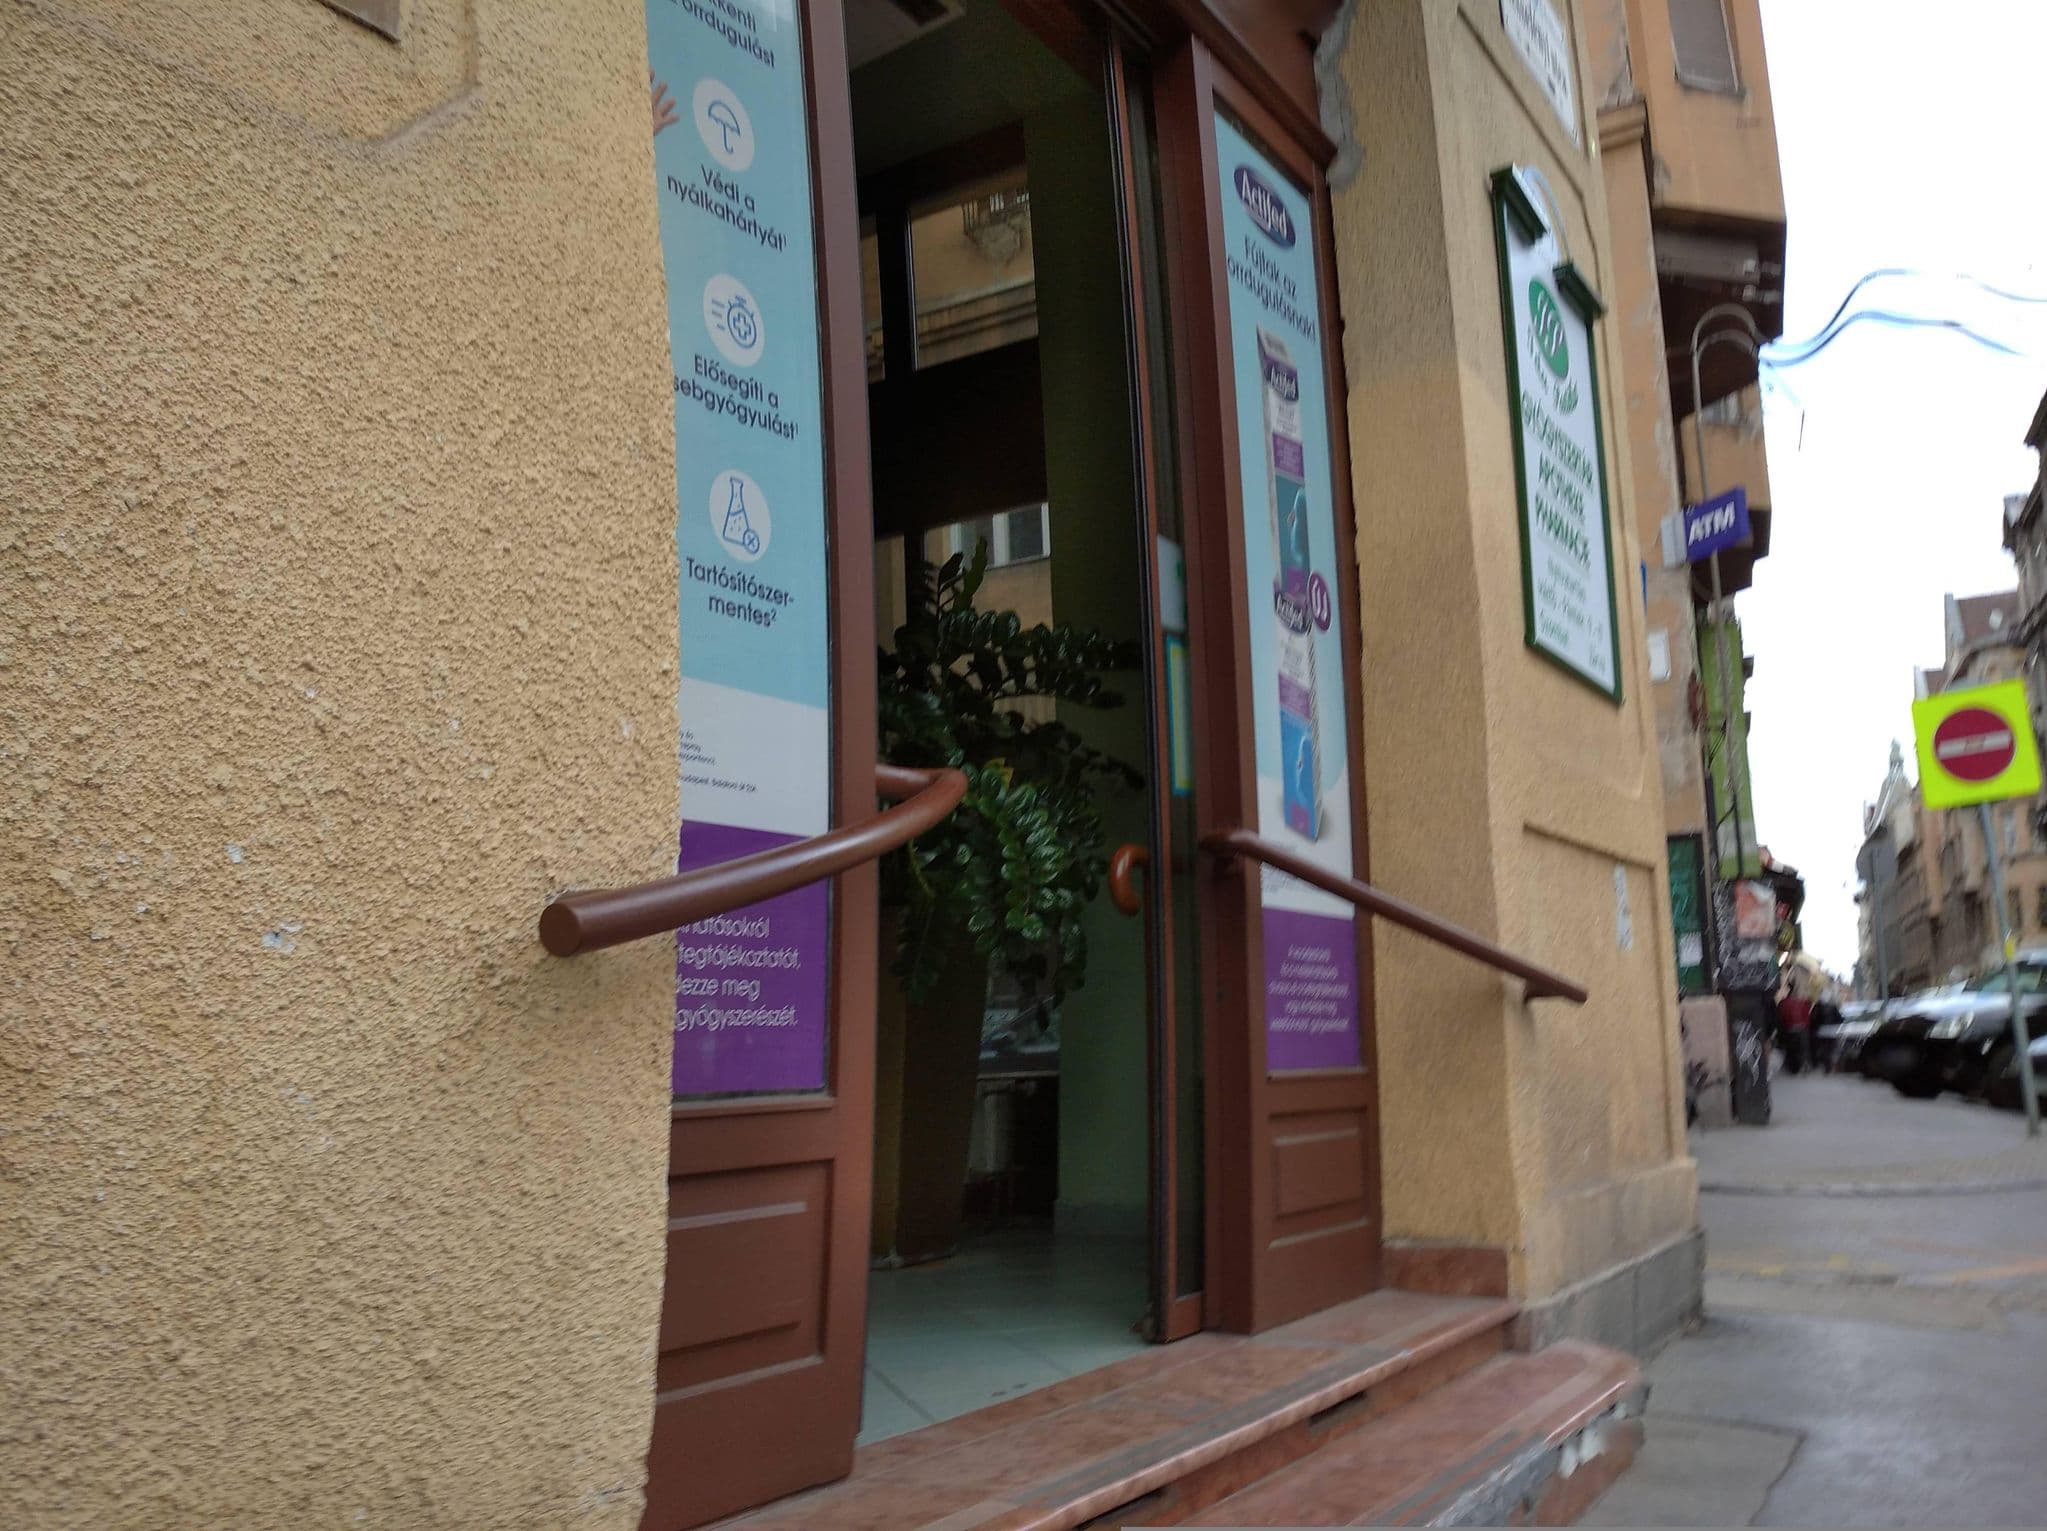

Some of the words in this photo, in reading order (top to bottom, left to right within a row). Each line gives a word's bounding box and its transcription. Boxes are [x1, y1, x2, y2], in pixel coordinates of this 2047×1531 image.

[701, 164, 739, 201] Védi
[744, 194, 755, 213] a
[694, 353, 764, 402] Elősegíti
[767, 391, 779, 410] a
[1688, 501, 1736, 547] ATM
[686, 556, 794, 607] Tartósítószer-
[721, 978, 761, 1001] meg
